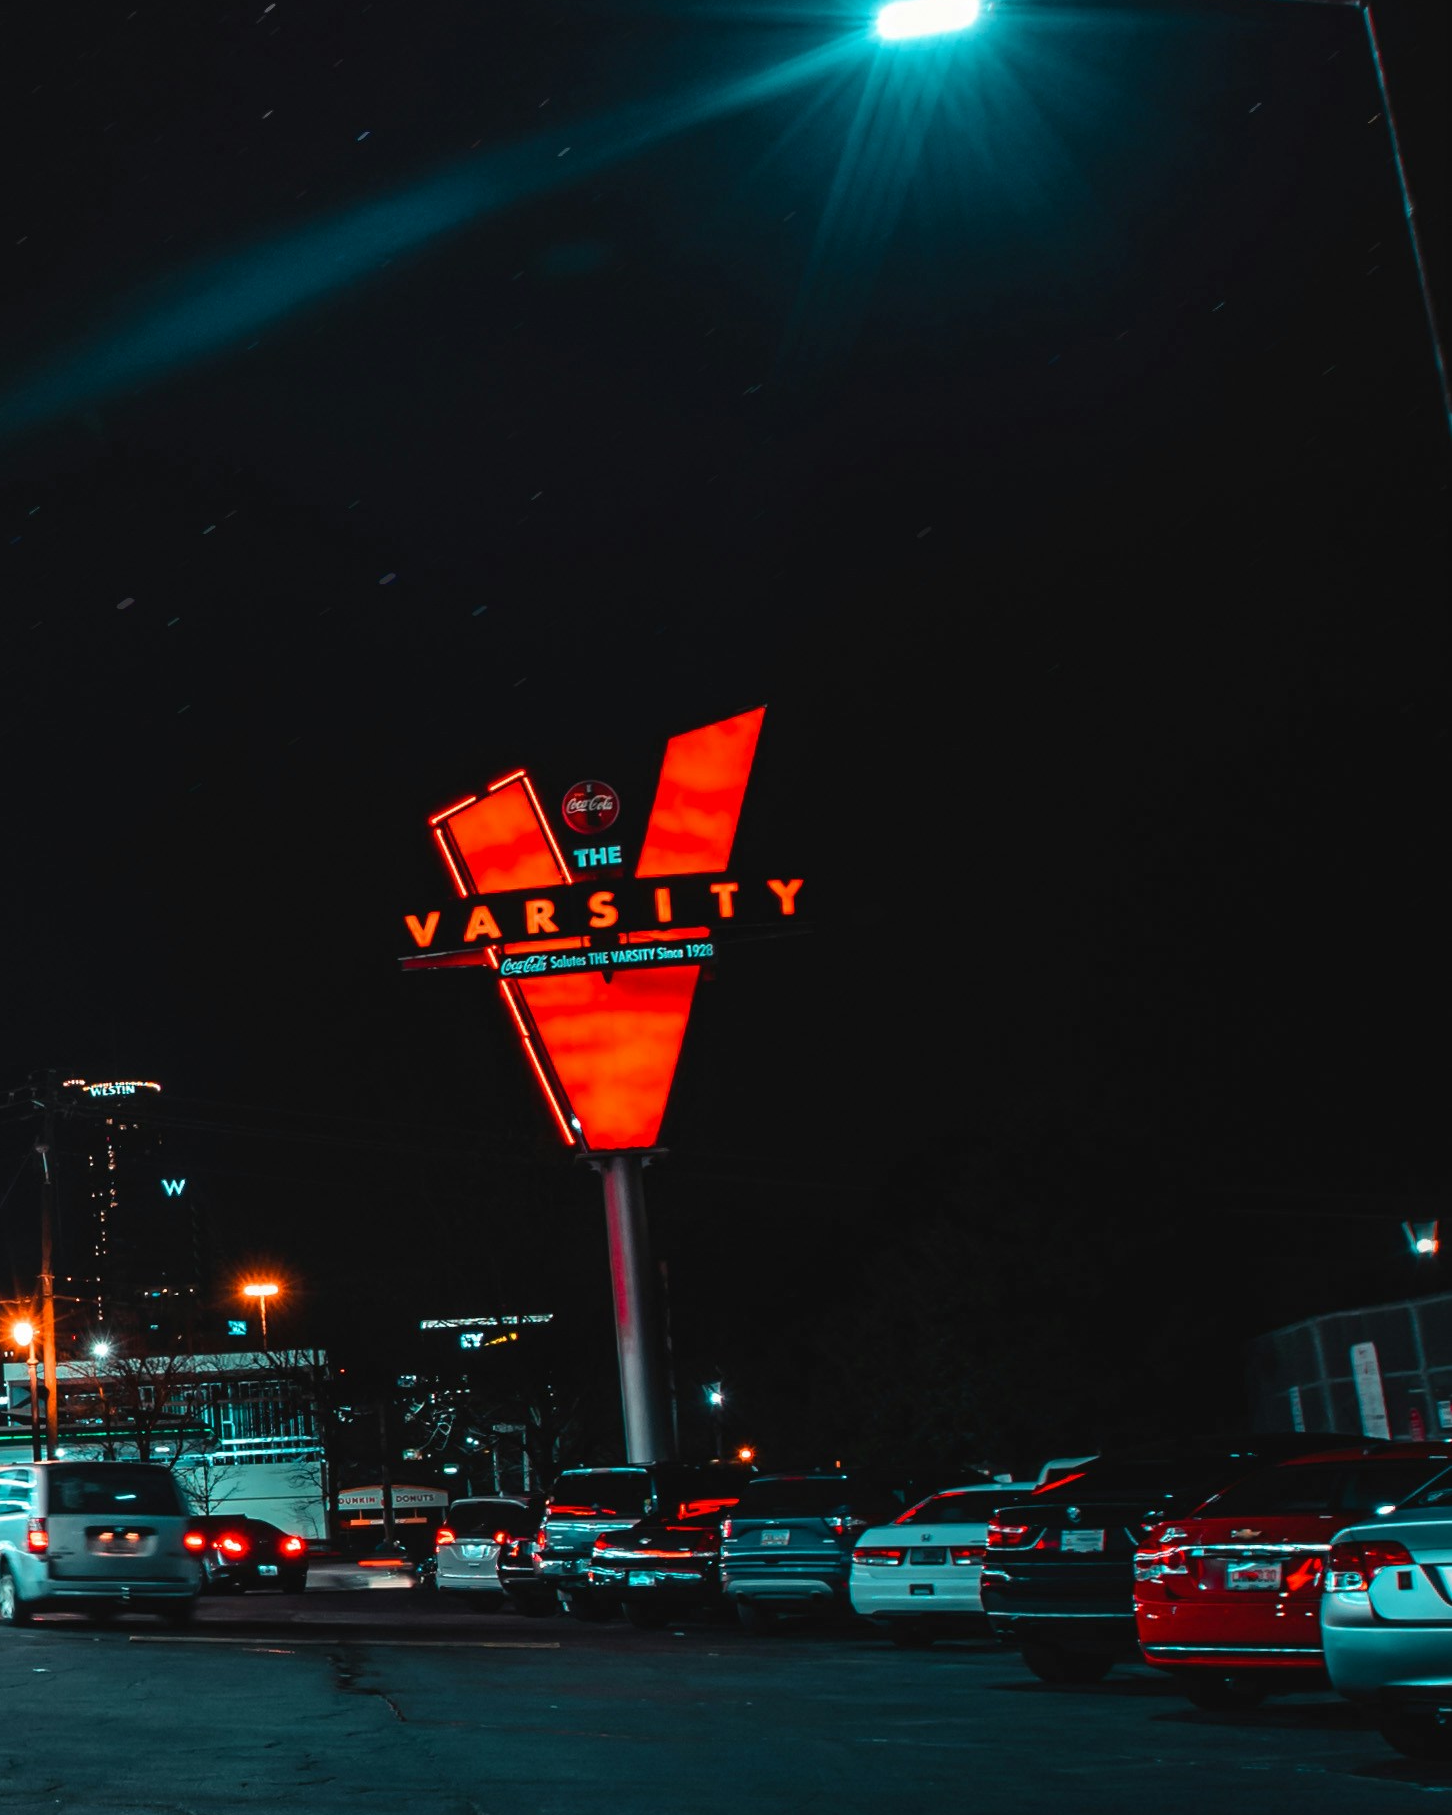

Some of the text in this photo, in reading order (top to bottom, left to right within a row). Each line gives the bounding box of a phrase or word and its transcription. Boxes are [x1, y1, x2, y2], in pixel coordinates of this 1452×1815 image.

[566, 795, 613, 814] Coca-Cola
[573, 845, 622, 867] THE
[405, 878, 804, 948] VARSITY
[500, 943, 714, 976] Coca-Cola Salutes THE VARSITY Since 1928
[88, 1084, 136, 1097] WESTIN
[160, 1177, 187, 1198] W
[396, 1493, 435, 1503] DONUTS
